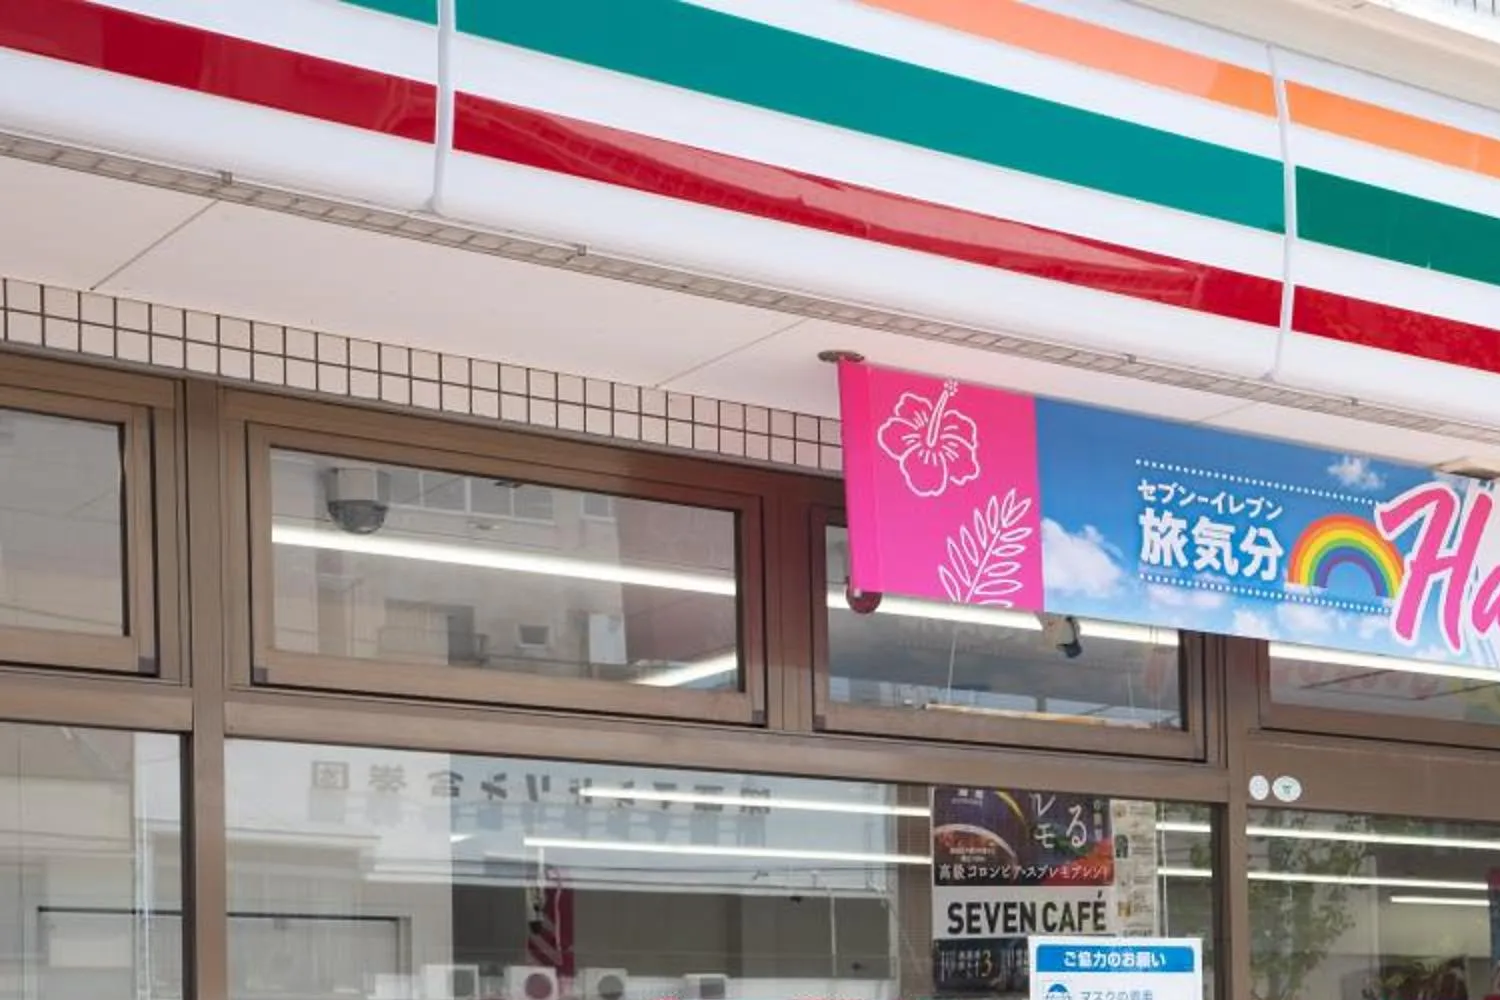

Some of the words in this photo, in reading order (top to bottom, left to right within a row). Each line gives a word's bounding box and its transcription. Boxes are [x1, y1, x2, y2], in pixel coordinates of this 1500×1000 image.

[1139, 507, 1284, 581] 旅気分
[947, 901, 1036, 935] SEVEN
[1063, 951, 1167, 968] ご協力のお願い
